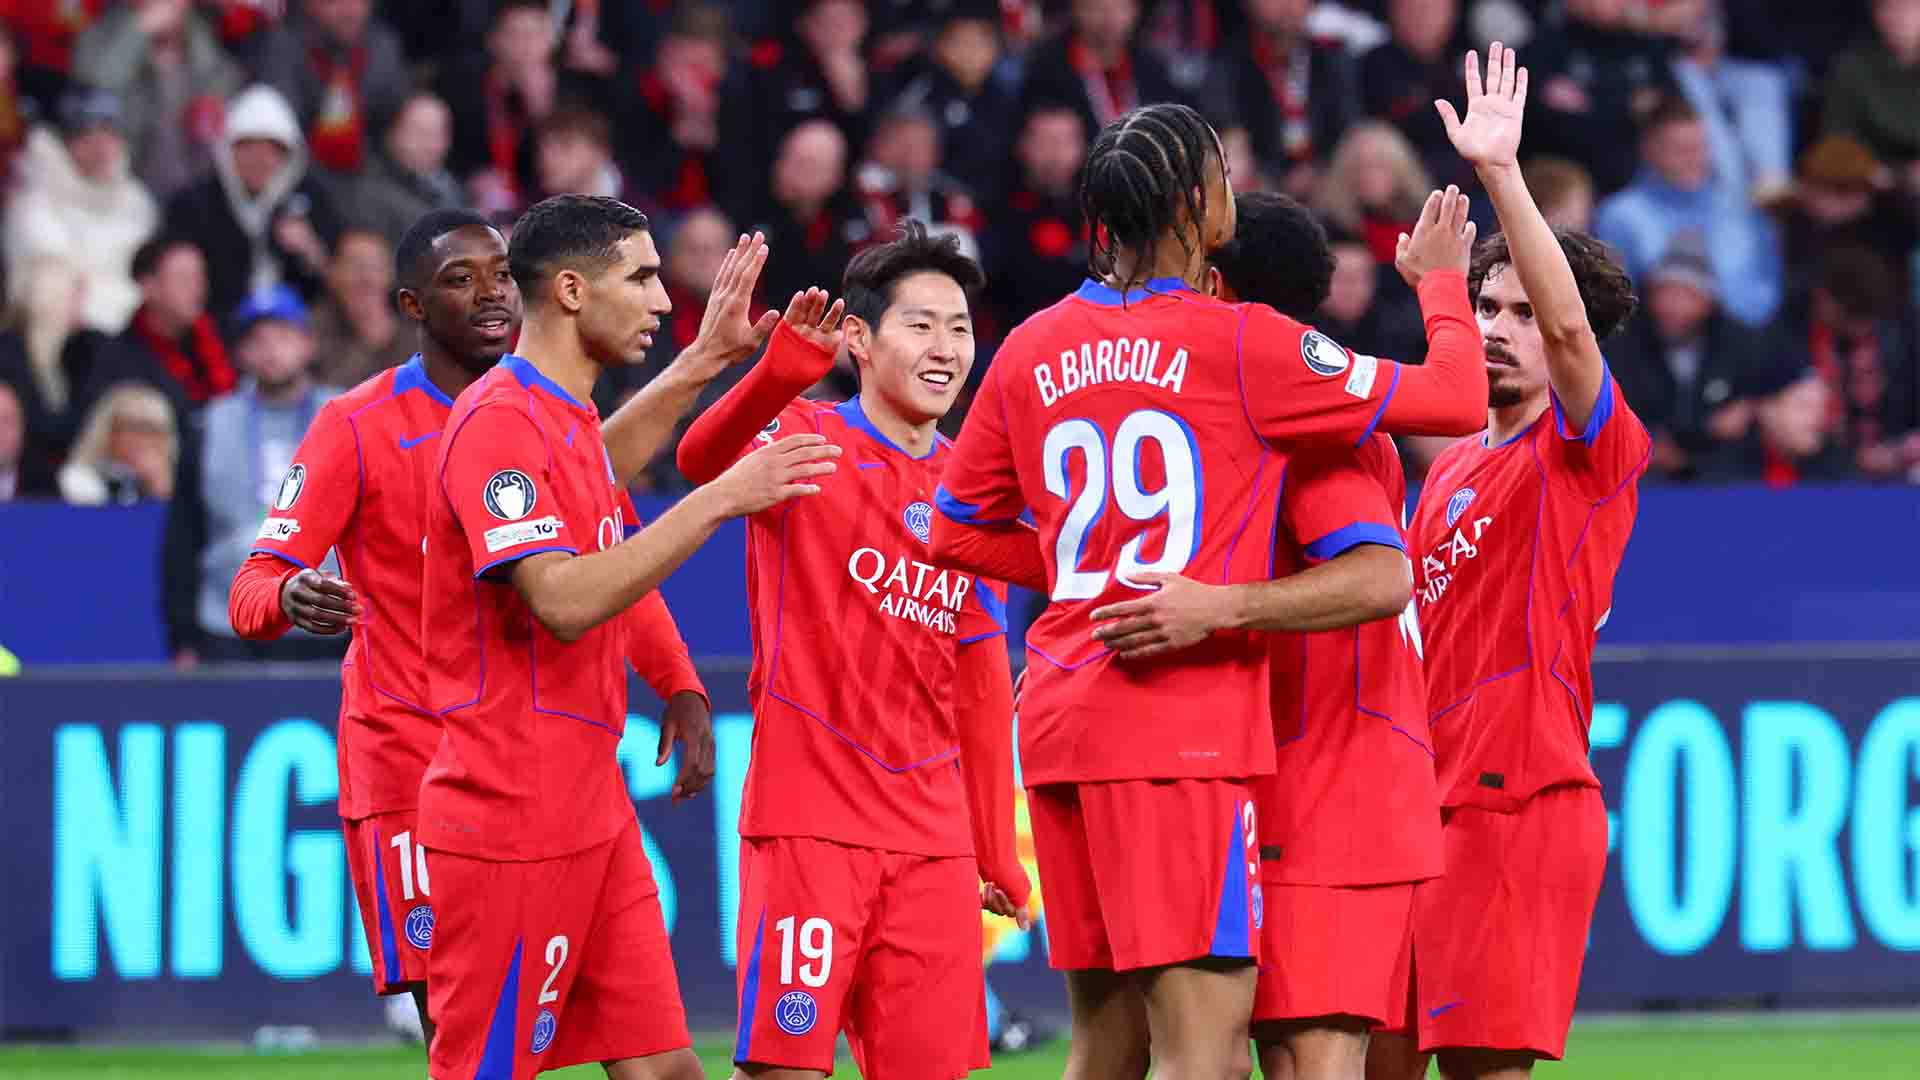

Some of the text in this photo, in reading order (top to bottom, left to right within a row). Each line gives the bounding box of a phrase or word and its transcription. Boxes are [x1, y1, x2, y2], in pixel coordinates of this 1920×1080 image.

[1034, 337, 1188, 407] B.BARCOLA
[1043, 408, 1205, 602] 29
[848, 547, 970, 612] QATAR
[879, 593, 956, 634] AIRWAYS
[538, 935, 568, 1005] 2
[776, 915, 833, 988] 19
[783, 993, 812, 1006] PARIS
